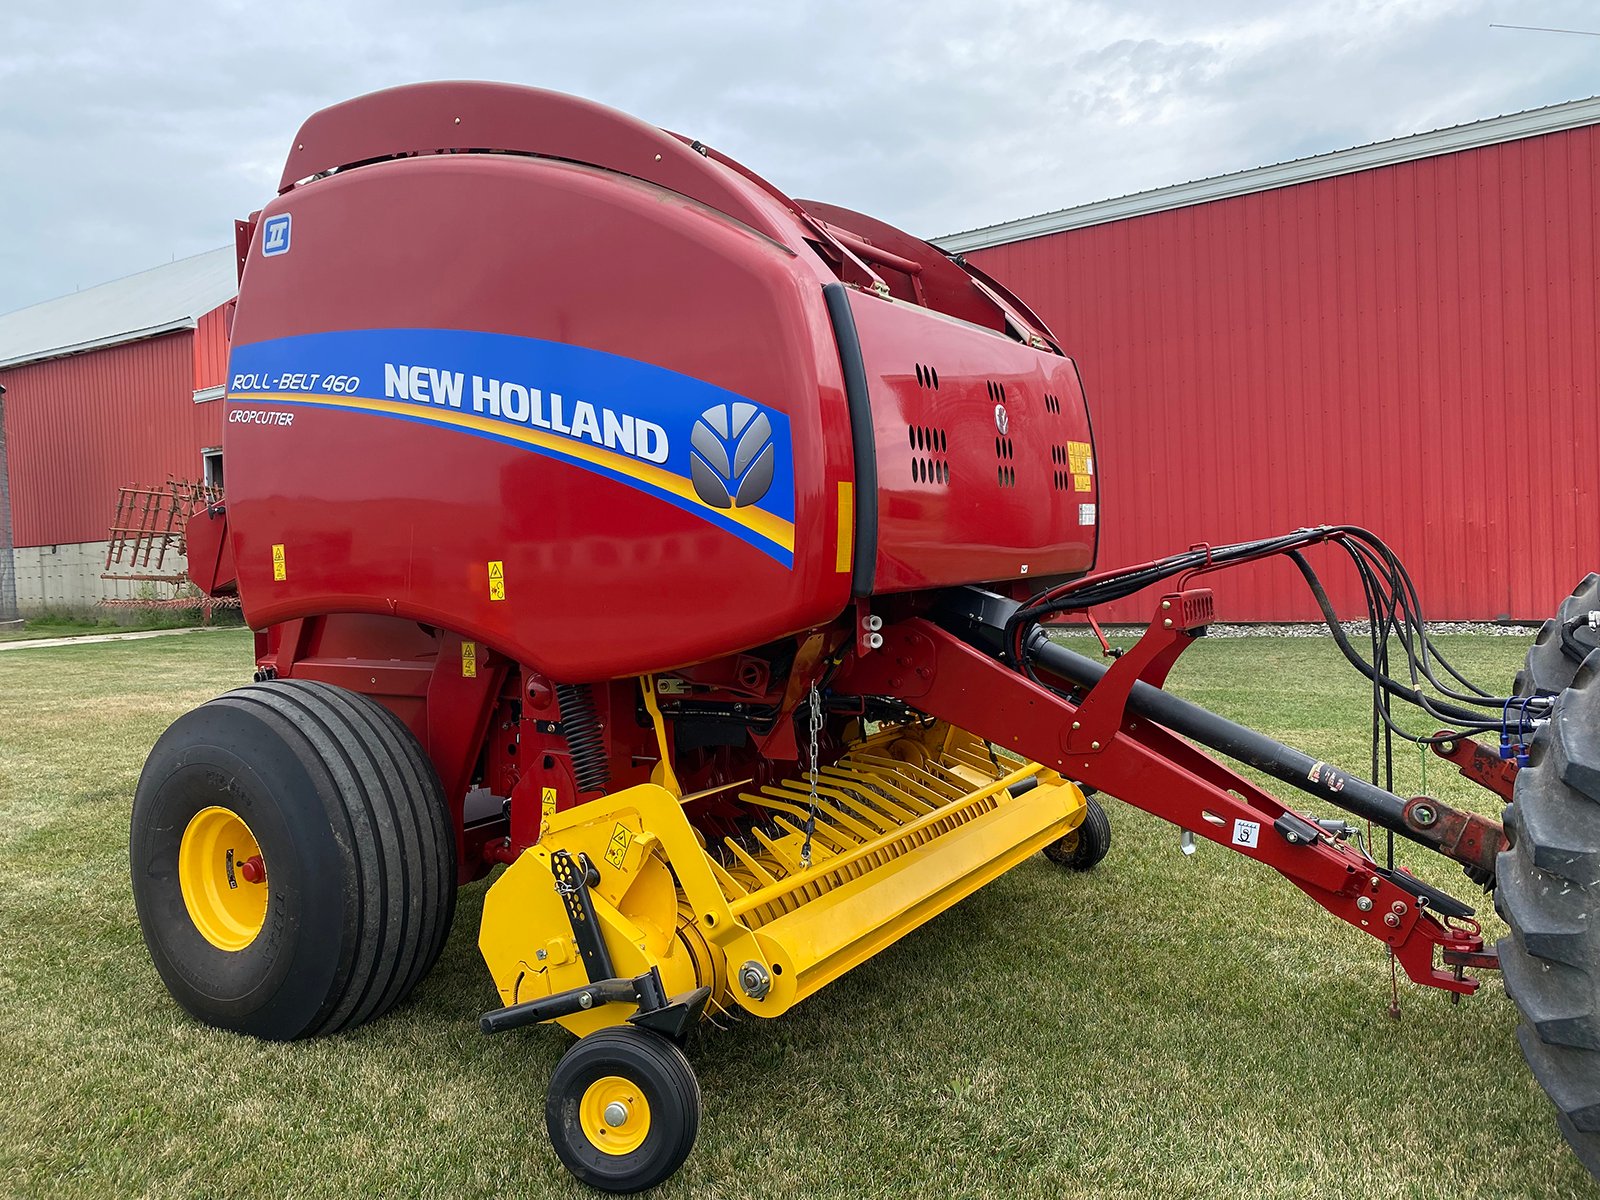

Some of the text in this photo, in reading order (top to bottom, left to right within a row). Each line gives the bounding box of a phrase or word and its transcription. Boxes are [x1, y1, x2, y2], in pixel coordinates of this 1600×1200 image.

[231, 373, 360, 393] ROLL-BELT 460
[228, 409, 294, 427] CROPCUTTER
[384, 362, 669, 464] NEW HOLLAND
